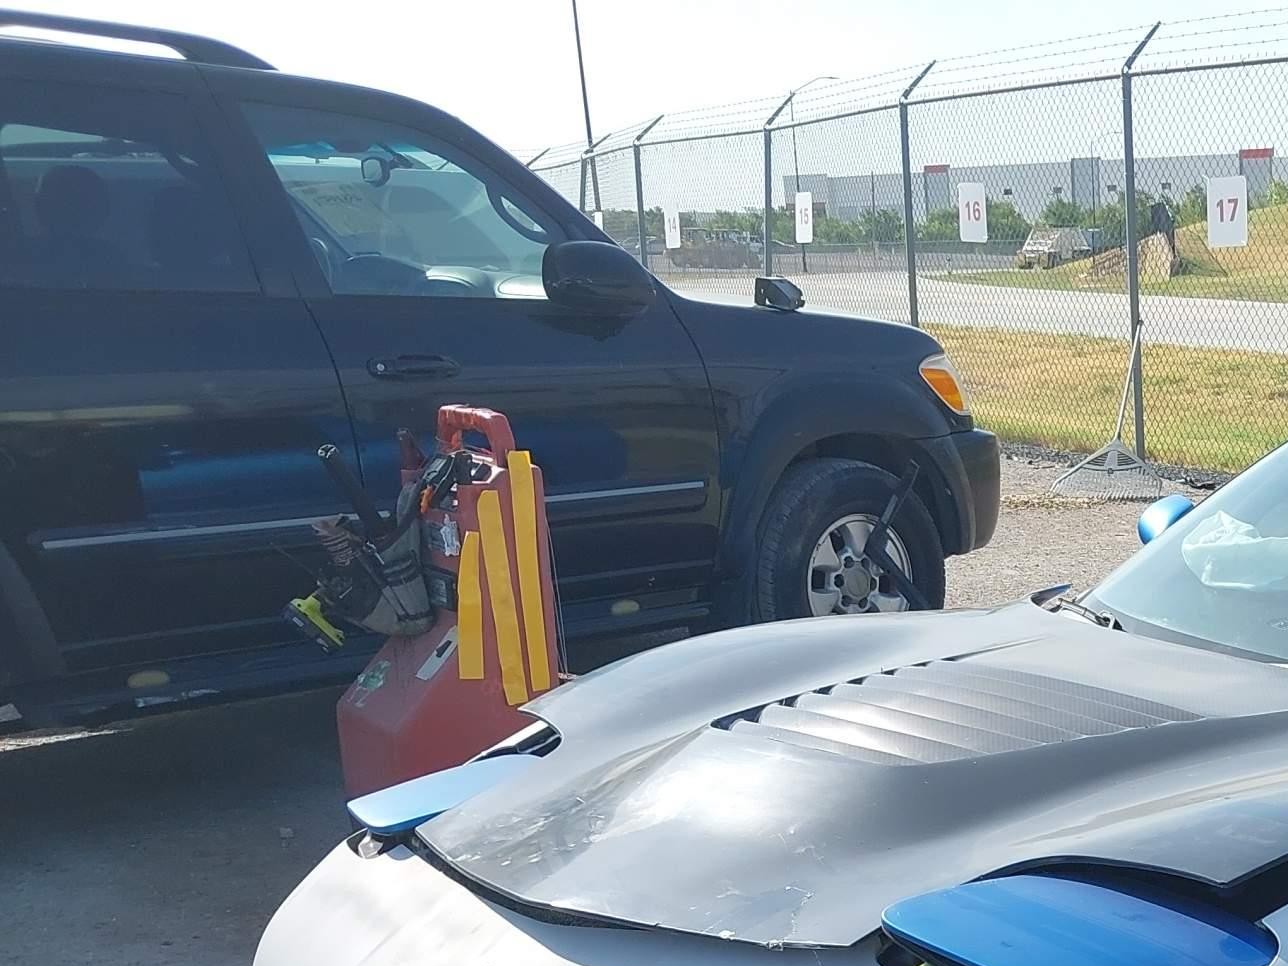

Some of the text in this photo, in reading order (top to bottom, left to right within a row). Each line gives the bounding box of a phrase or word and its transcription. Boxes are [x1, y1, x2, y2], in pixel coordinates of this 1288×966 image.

[799, 208, 809, 225] 15
[964, 201, 982, 222] 16
[1216, 198, 1239, 223] 17
[668, 217, 677, 233] 14
